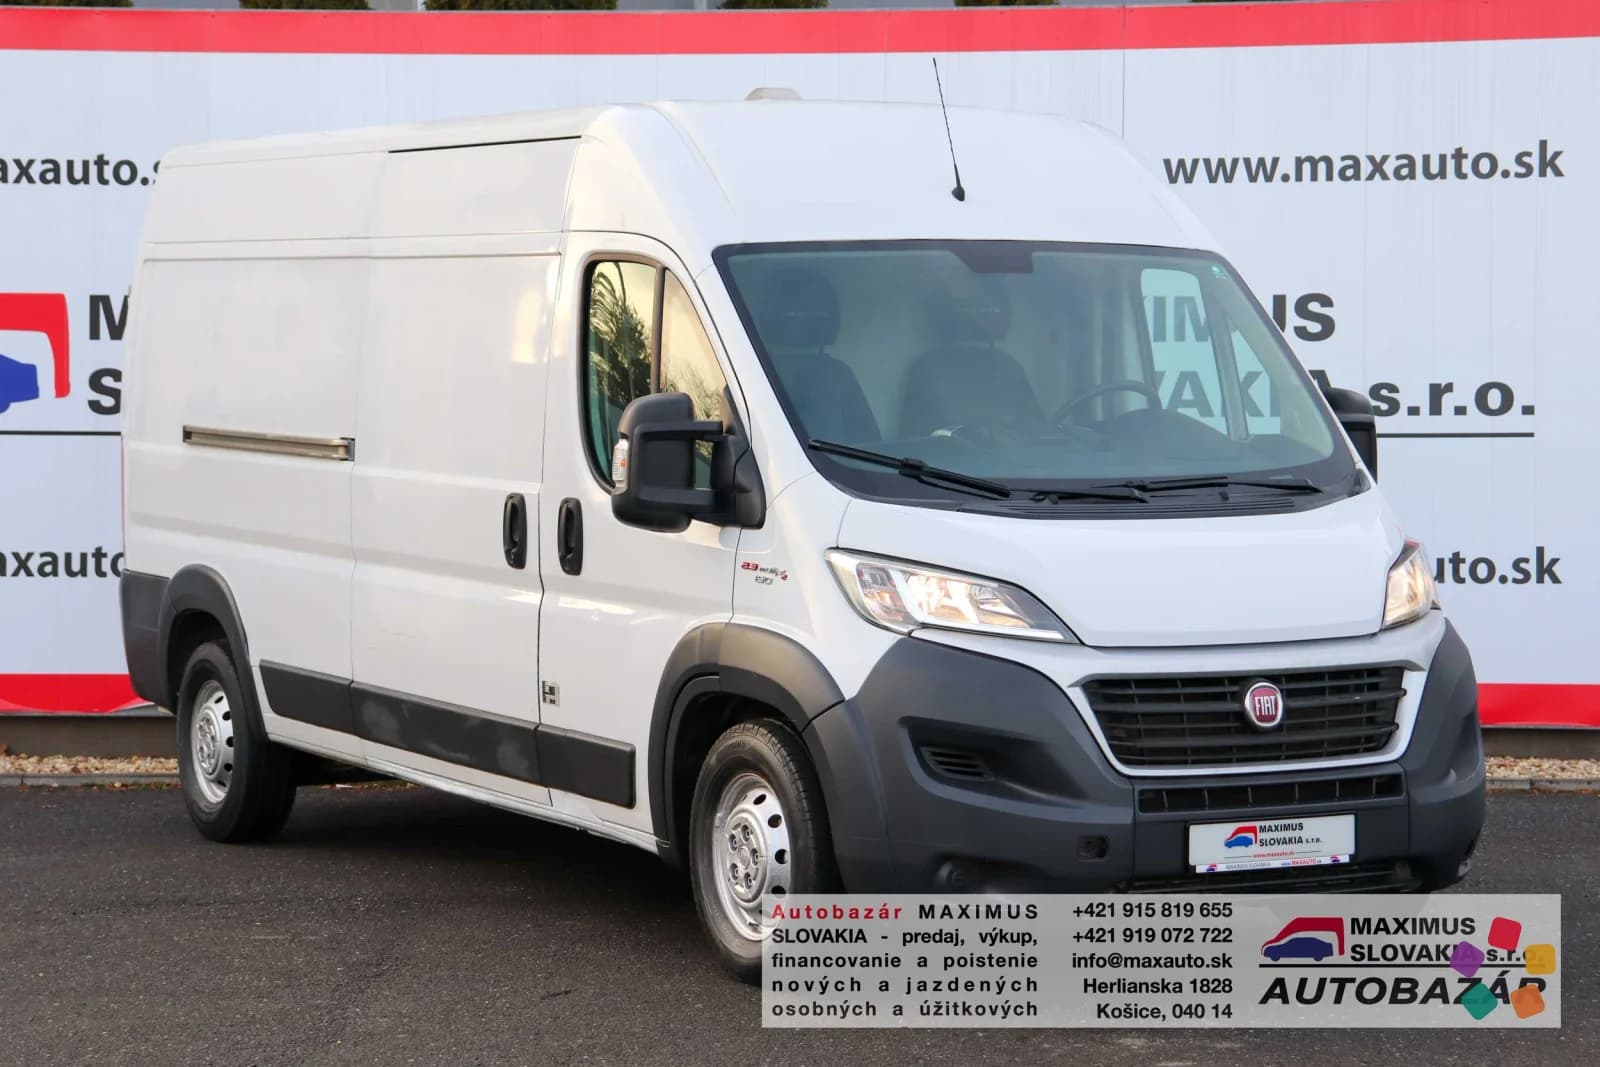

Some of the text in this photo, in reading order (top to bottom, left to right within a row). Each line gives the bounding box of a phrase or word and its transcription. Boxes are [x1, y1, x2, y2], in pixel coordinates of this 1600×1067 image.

[0, 154, 160, 186] xauto.
[1163, 140, 1564, 184] www.maxauto.sk
[1369, 381, 1536, 416] s.r.o.
[1255, 695, 1276, 716] FIAT
[1258, 822, 1304, 833] MAXIMUS
[1258, 836, 1303, 847] SLOVAKIA
